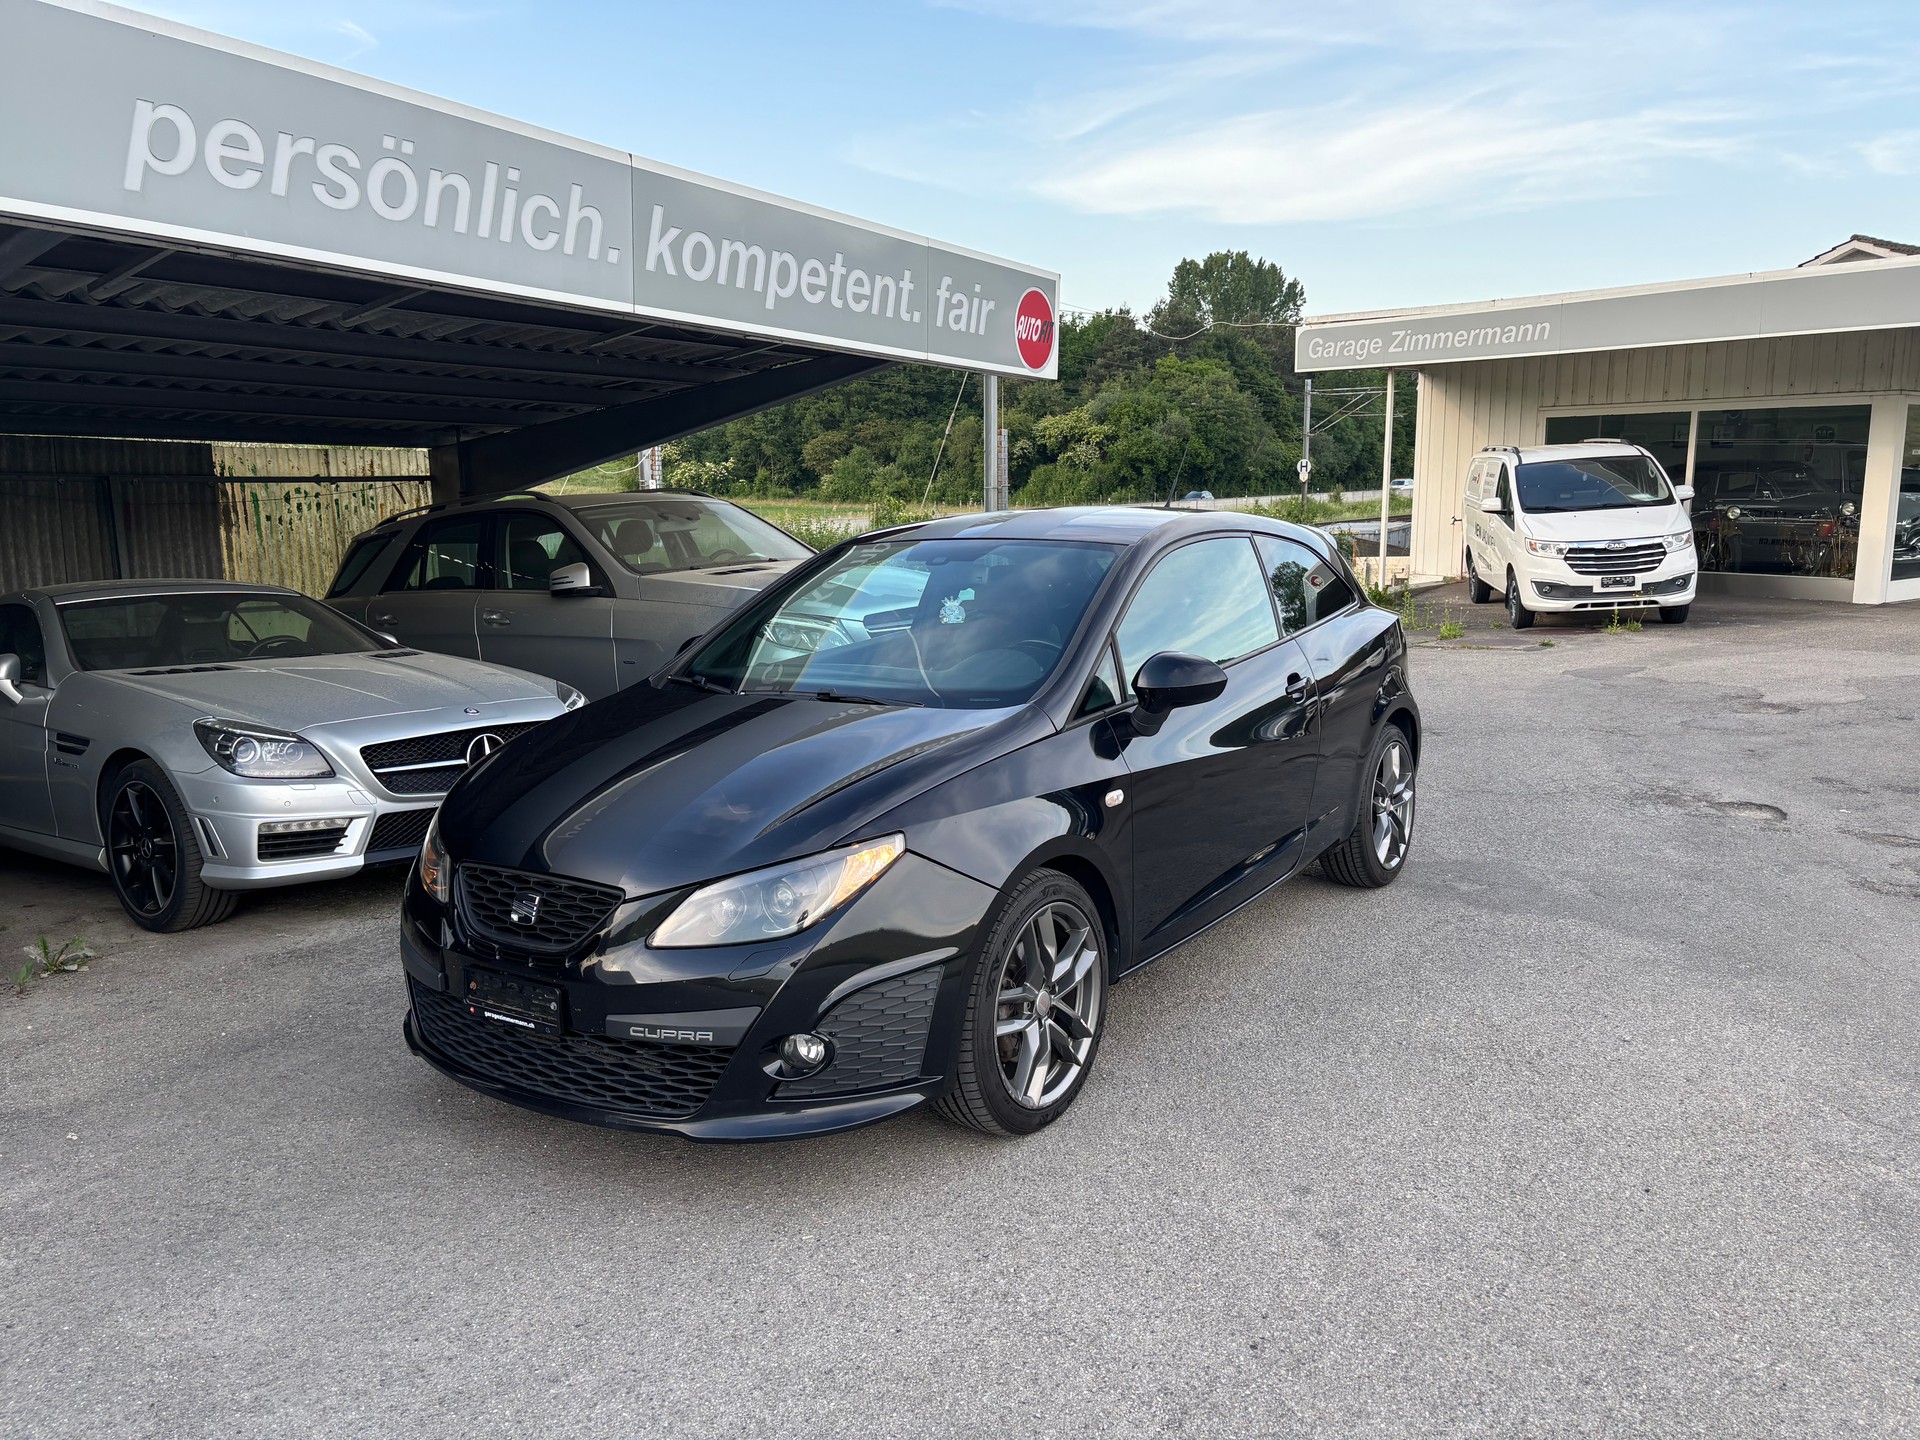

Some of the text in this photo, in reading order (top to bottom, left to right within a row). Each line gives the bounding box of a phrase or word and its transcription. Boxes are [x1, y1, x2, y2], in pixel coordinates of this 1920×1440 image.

[123, 98, 996, 335] persönlich. kompetent. fair
[1308, 321, 1551, 361] Garage Zimmermann
[1300, 461, 1308, 472] H
[629, 1026, 713, 1042] CUPRA
